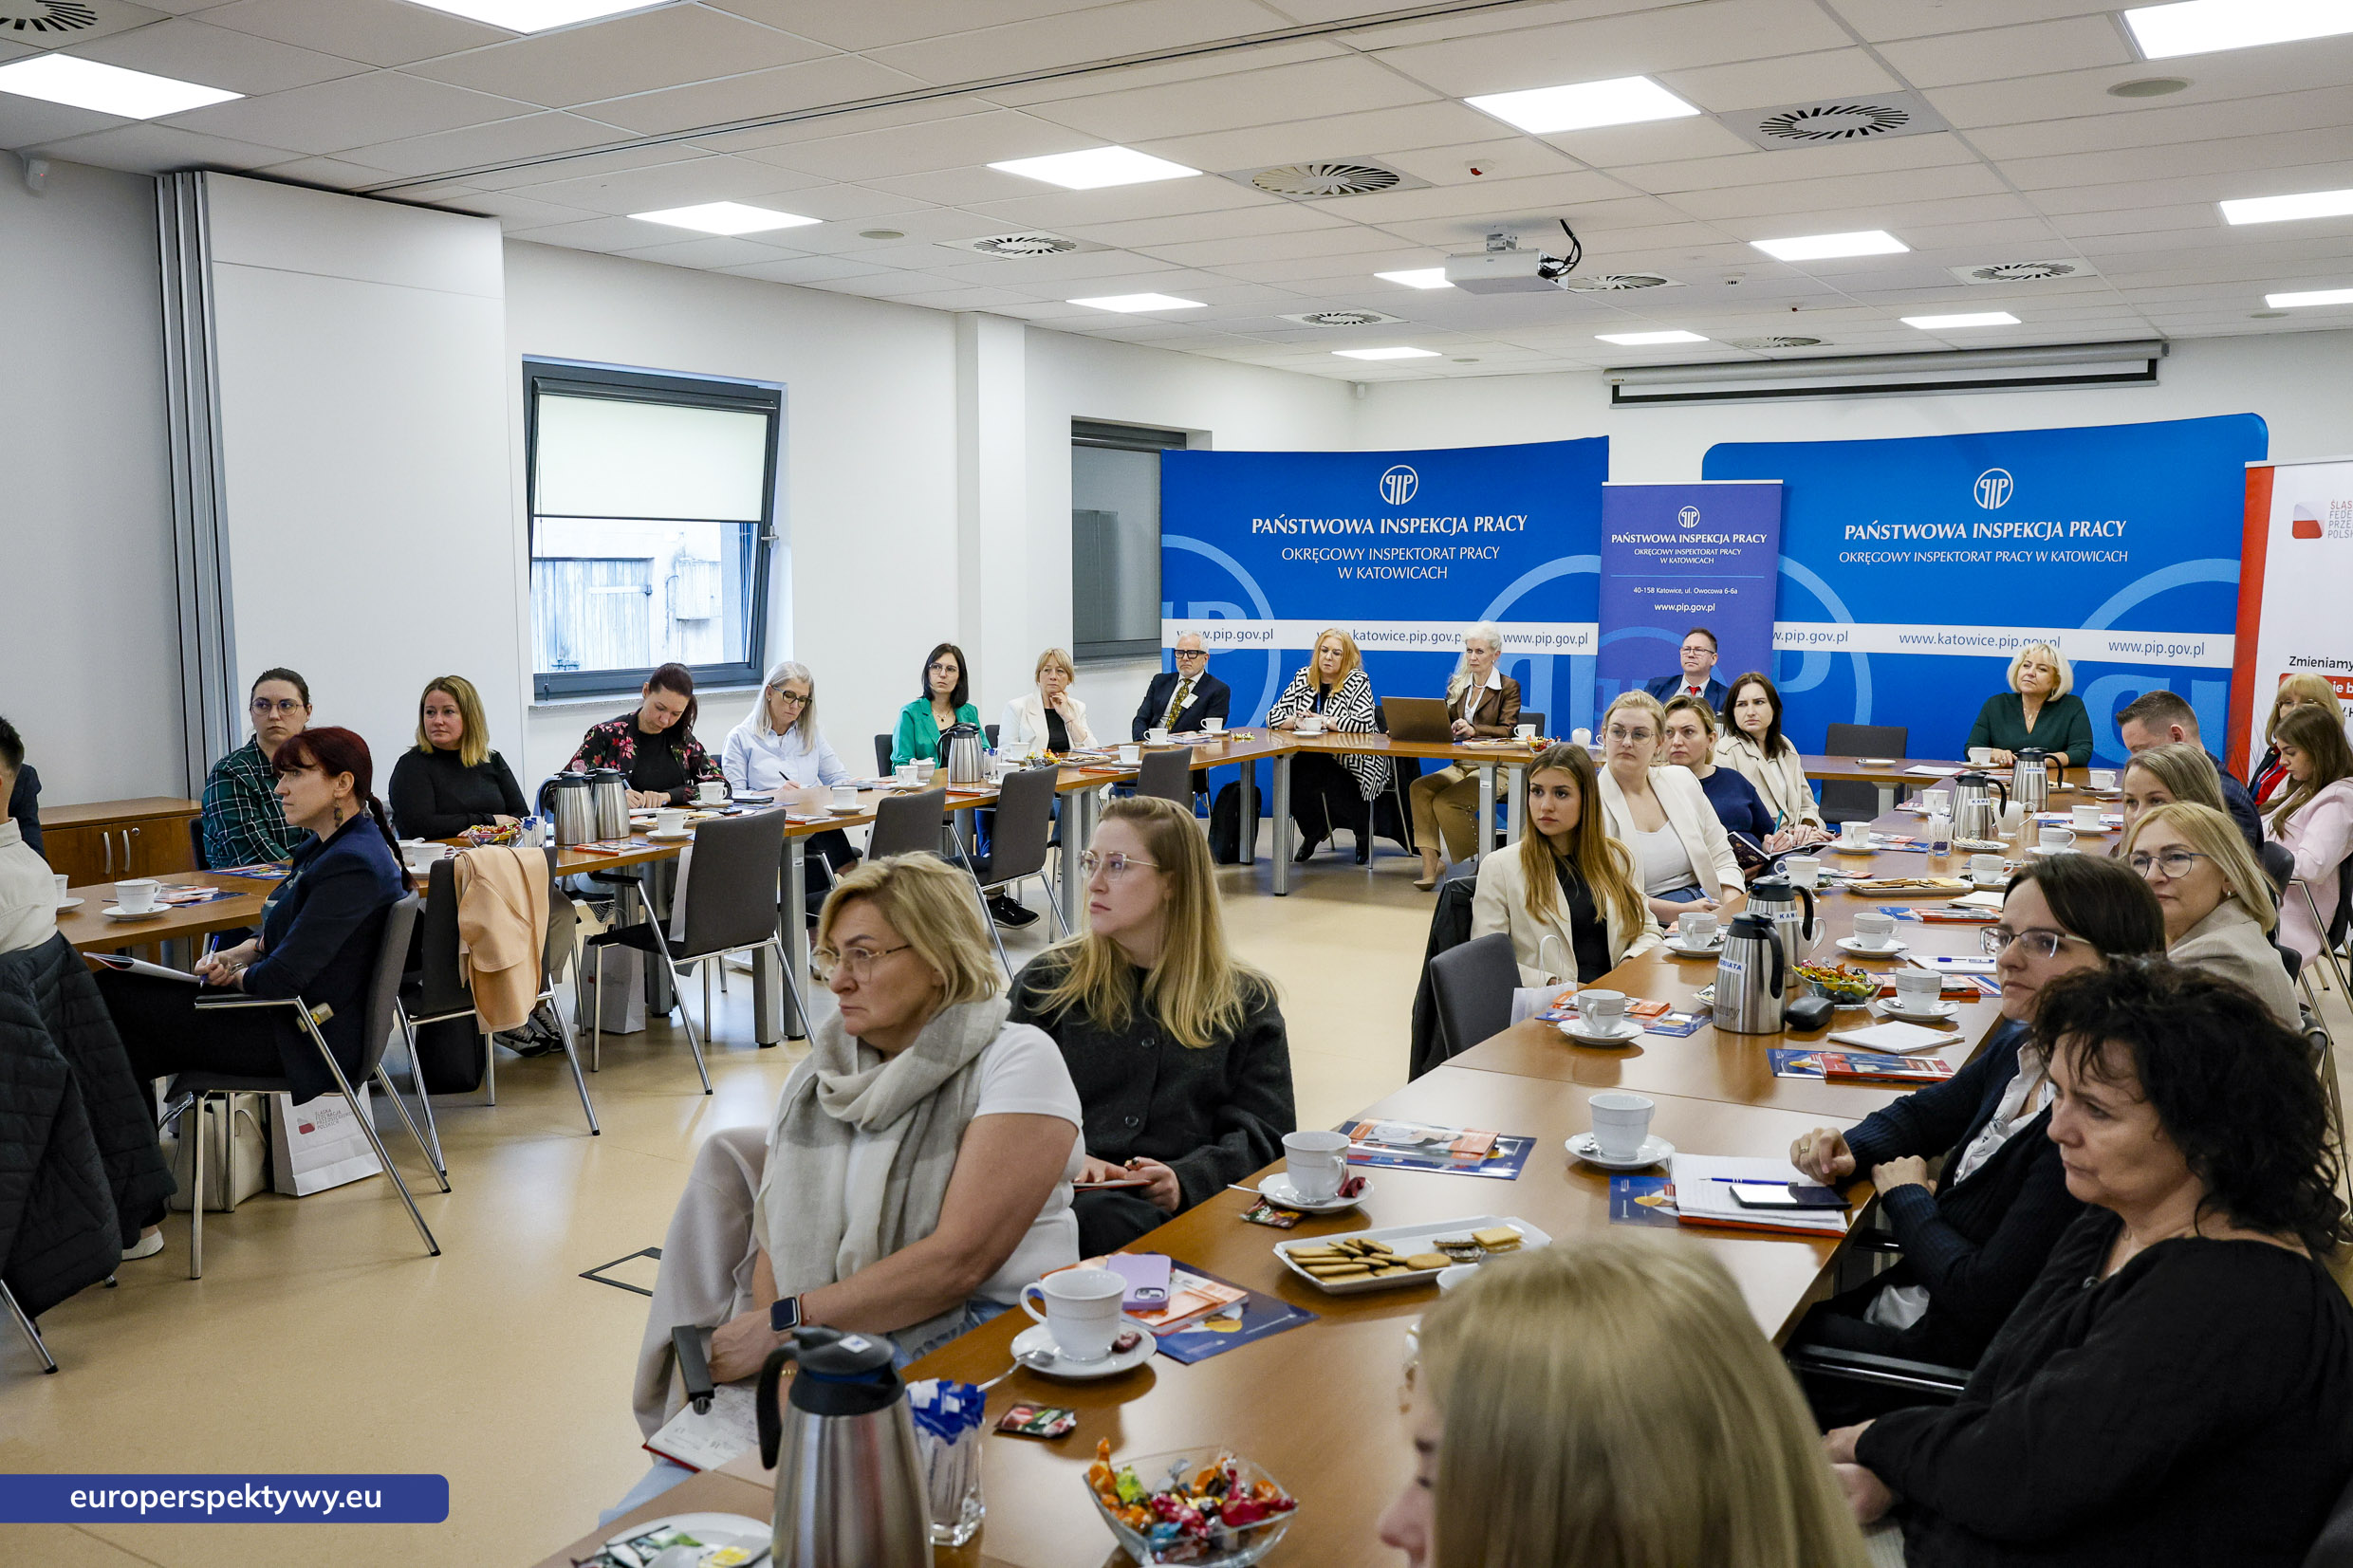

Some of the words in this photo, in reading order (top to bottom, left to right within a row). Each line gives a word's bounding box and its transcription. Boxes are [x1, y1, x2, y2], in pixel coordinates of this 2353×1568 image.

[2329, 510, 2353, 519] FEDE
[1252, 513, 1375, 534] PAŃSTWOWA
[1380, 516, 1469, 536] INSPEKCJA
[1473, 514, 1528, 532] PRACY
[1844, 520, 1968, 540] PAŃSTWOWA
[1973, 521, 2064, 541] INSPEKCJA
[2069, 520, 2127, 537] PRACY
[2328, 520, 2353, 528] PRZE
[1611, 532, 1677, 544] PAŃSTWOWA
[1678, 533, 1731, 544] INSPEKCJA
[1732, 533, 1768, 544] PRACY
[1282, 547, 1365, 563] OKRĘGOWY
[1369, 547, 1456, 561] INSPEKTORAT
[1459, 546, 1500, 560] PRACY
[1634, 548, 1674, 557] OKRĘGOWY
[1839, 551, 1911, 565] OKRĘGOWY
[1914, 550, 1992, 563] INSPEKTORAT
[1995, 550, 2033, 563] PRACY
[2035, 550, 2048, 563] W
[2051, 550, 2128, 563] KATOWICACH
[1337, 566, 1353, 580] W
[1357, 566, 1448, 580] KATOWICACH
[1656, 586, 1683, 595] Katowice,
[1654, 602, 1715, 613] www.pip.gov.pl
[1176, 628, 1273, 642] w.pip.gov.pl
[1317, 629, 1464, 644] katowice.pip.gov.p
[1503, 632, 1588, 647] www.pip.gov.pl
[1772, 629, 1848, 644] w.pip.gov.pl
[1899, 633, 2061, 649] www.katowice.pip.govpl
[2108, 640, 2205, 658] www.pip.gov.pl
[2289, 655, 2353, 672] Zmieniamy
[2332, 681, 2344, 693] ie
[1719, 959, 1742, 971] ERBATA
